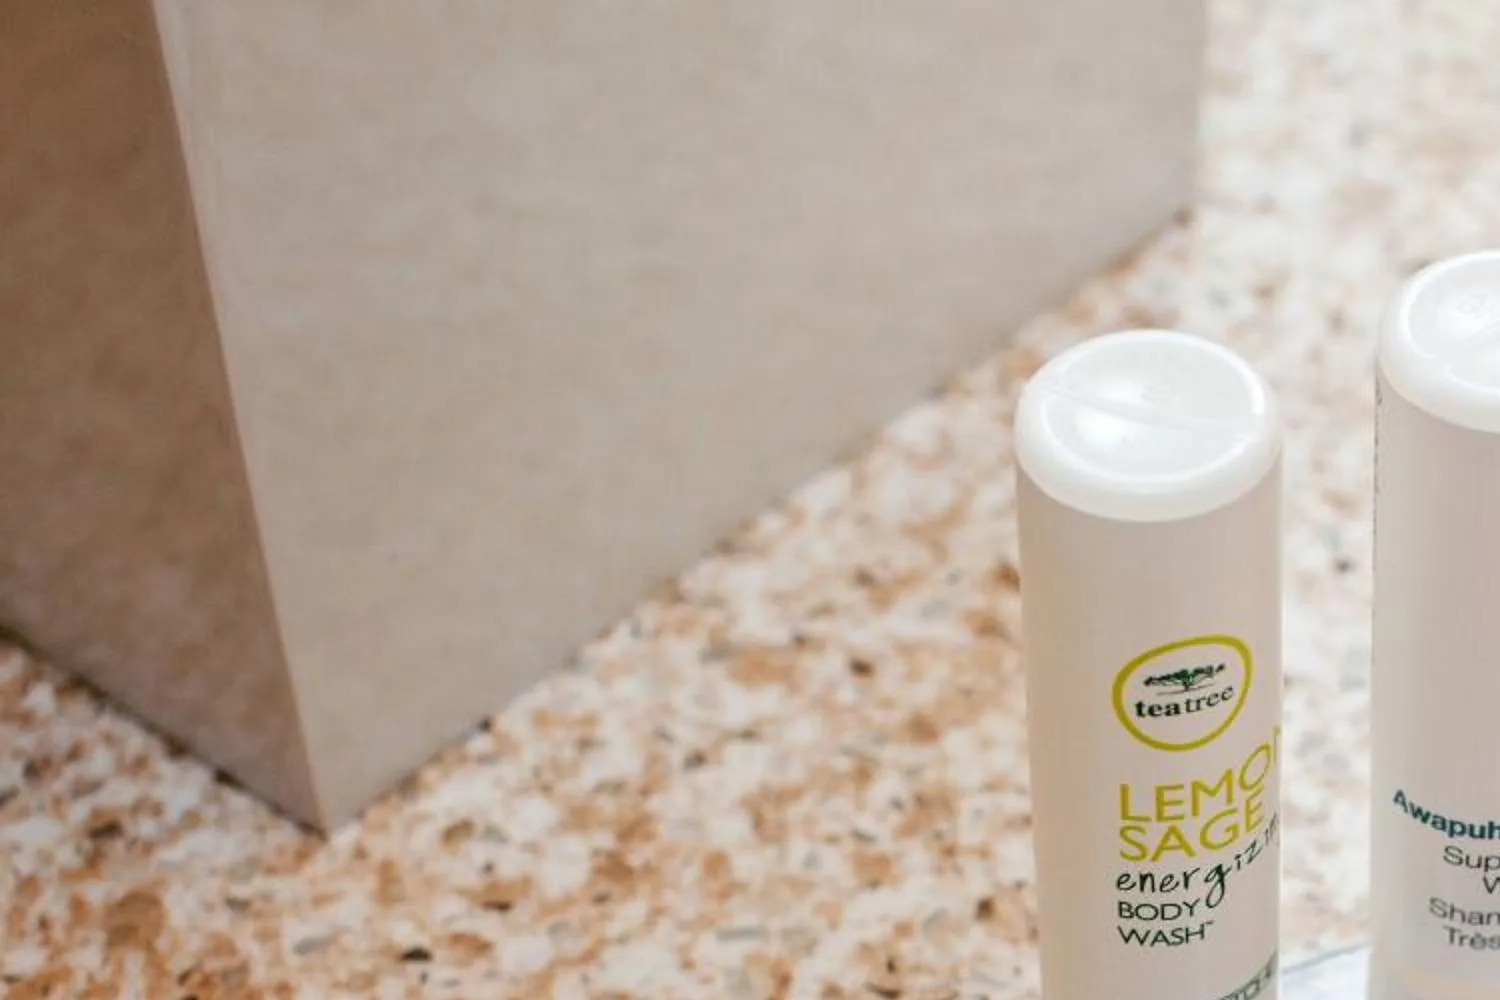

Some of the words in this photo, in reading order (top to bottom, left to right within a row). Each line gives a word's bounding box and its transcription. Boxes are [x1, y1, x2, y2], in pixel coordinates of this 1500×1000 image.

[1119, 784, 1265, 862] SAGE
[1117, 899, 1200, 921] BODY
[1117, 922, 1205, 947] WASH
